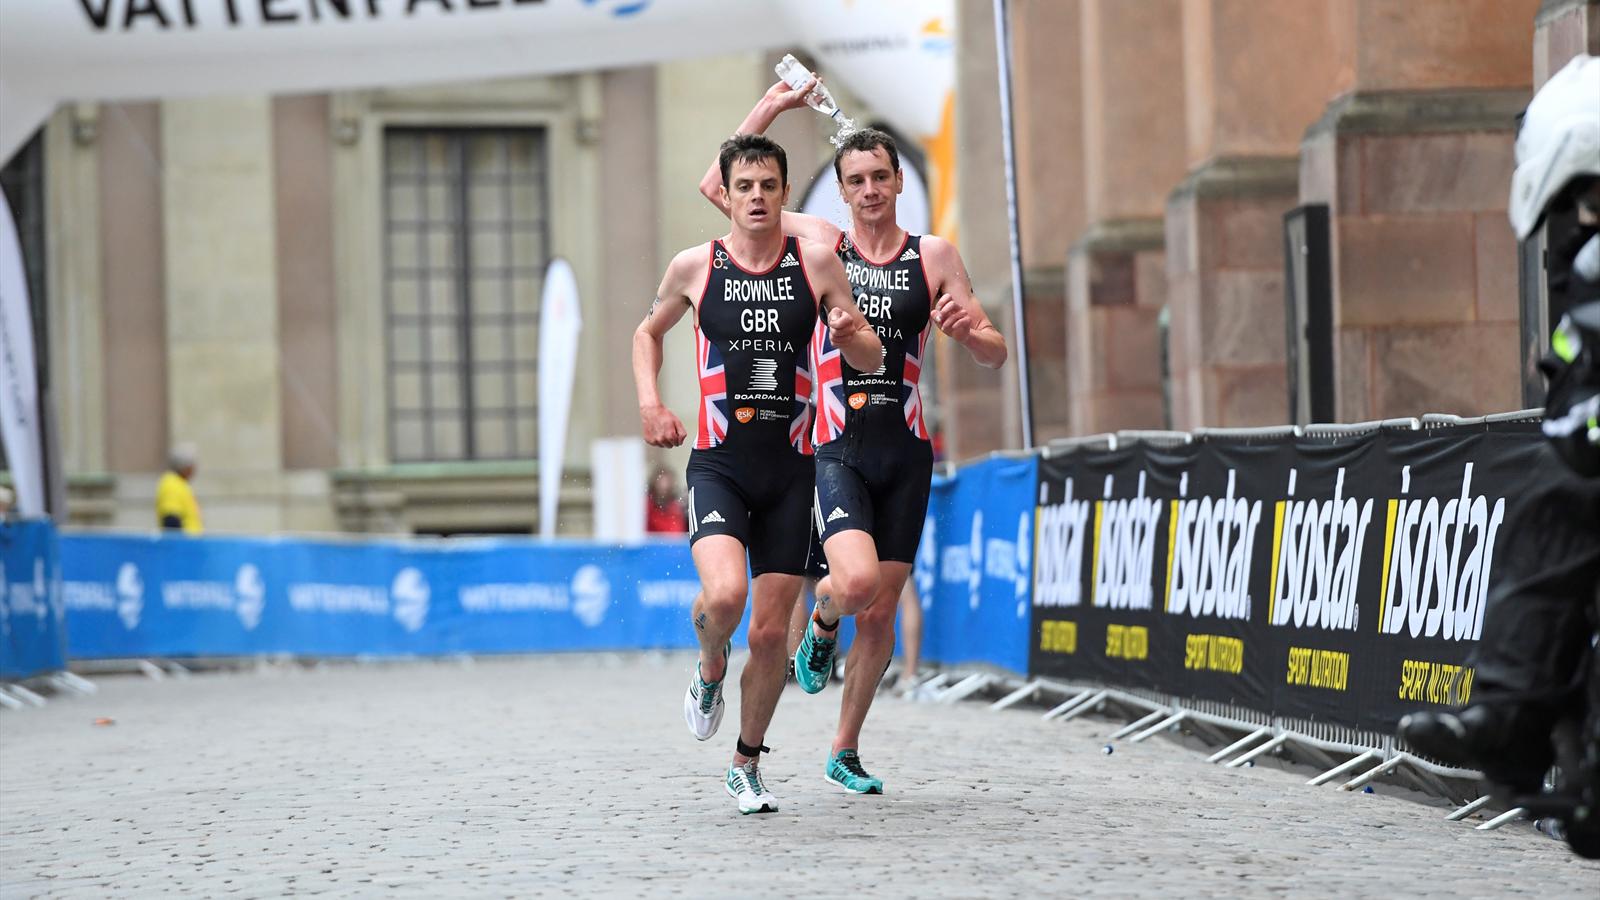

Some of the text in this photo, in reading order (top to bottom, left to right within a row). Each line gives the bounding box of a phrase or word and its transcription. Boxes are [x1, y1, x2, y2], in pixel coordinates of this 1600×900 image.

[724, 276, 795, 301] BROWNLEE
[846, 262, 910, 291] BROWNLEE
[857, 293, 892, 320] GBR
[740, 308, 780, 333] GBR
[729, 339, 794, 353] XPERIA
[847, 378, 896, 386] BOARDMAN
[734, 393, 790, 401] BOARDMAN
[737, 409, 753, 421] gsk
[1287, 647, 1349, 691] SPORT NUTRITION
[1399, 660, 1430, 701] SPORT
